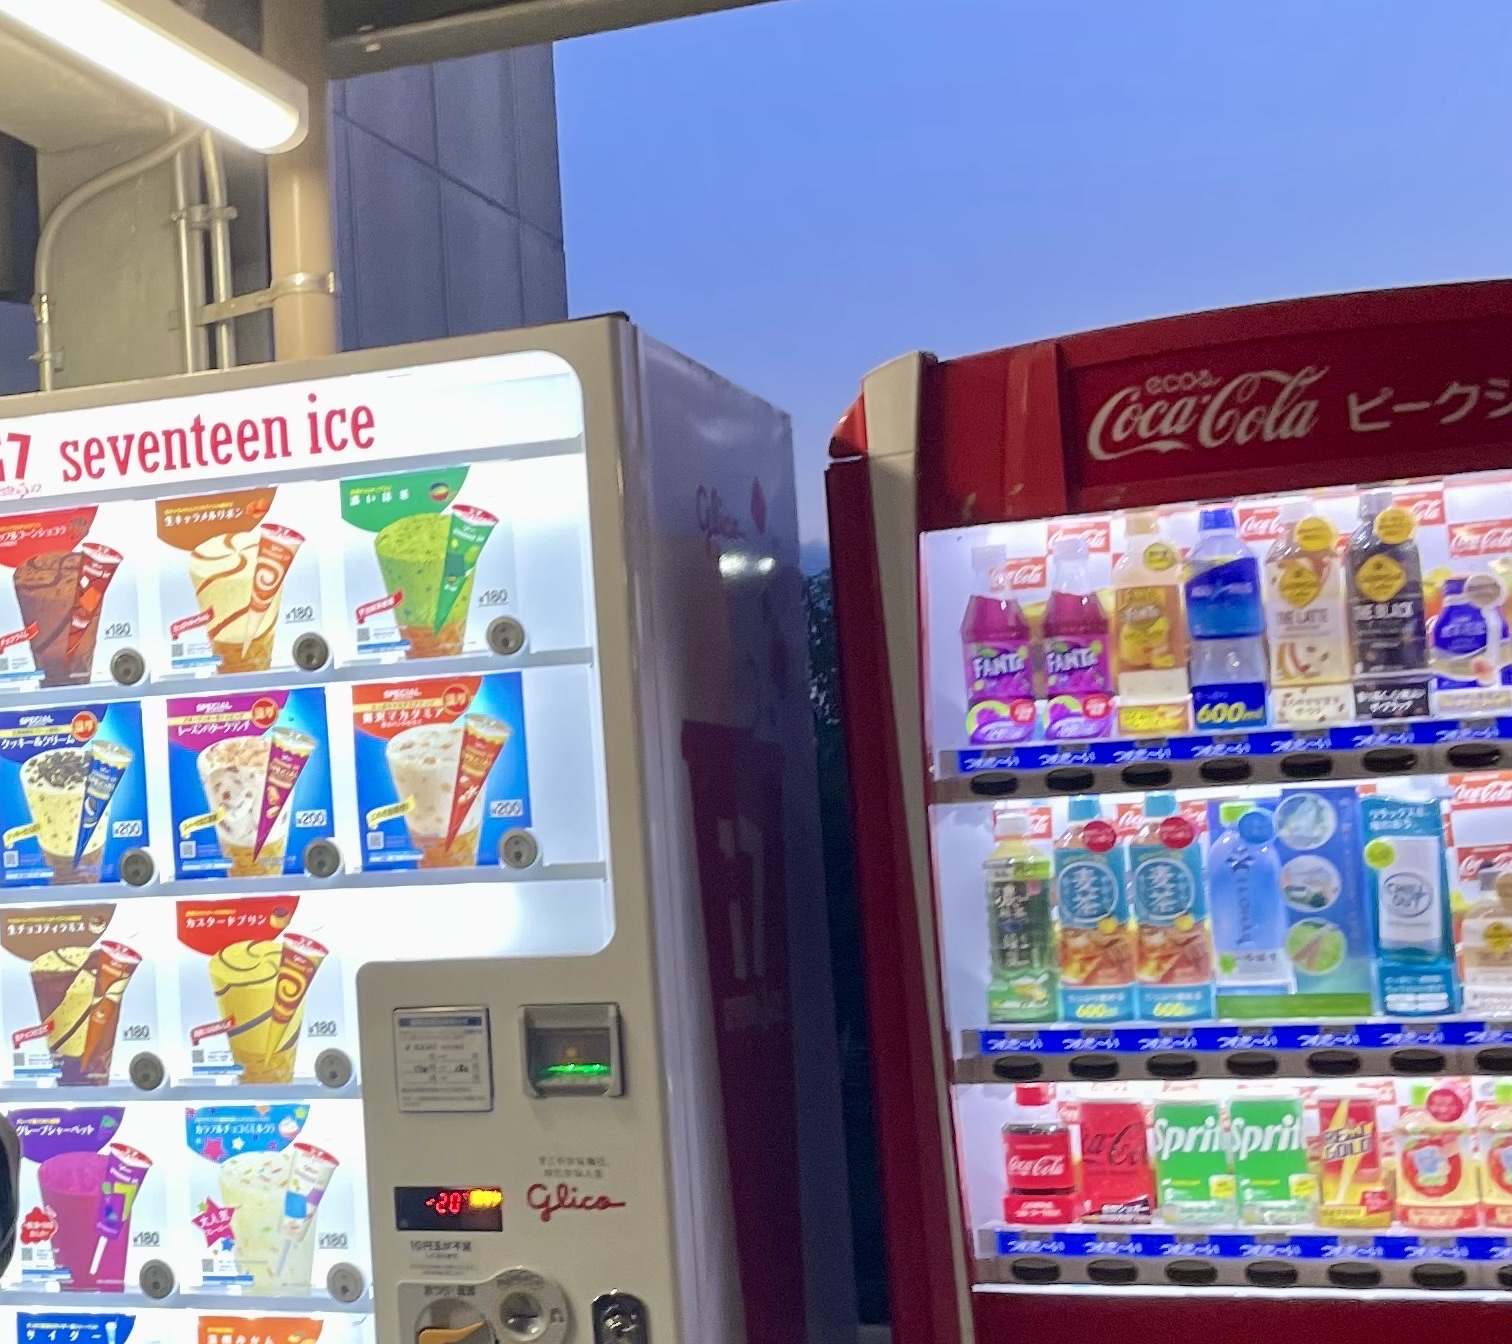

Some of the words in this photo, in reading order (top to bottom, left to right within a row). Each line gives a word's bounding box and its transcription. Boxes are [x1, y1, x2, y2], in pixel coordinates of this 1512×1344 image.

[59, 414, 292, 482] seventeen
[307, 392, 376, 455] ice
[1088, 365, 1330, 460] Coca-Cola
[527, 1183, 627, 1223] Glico
